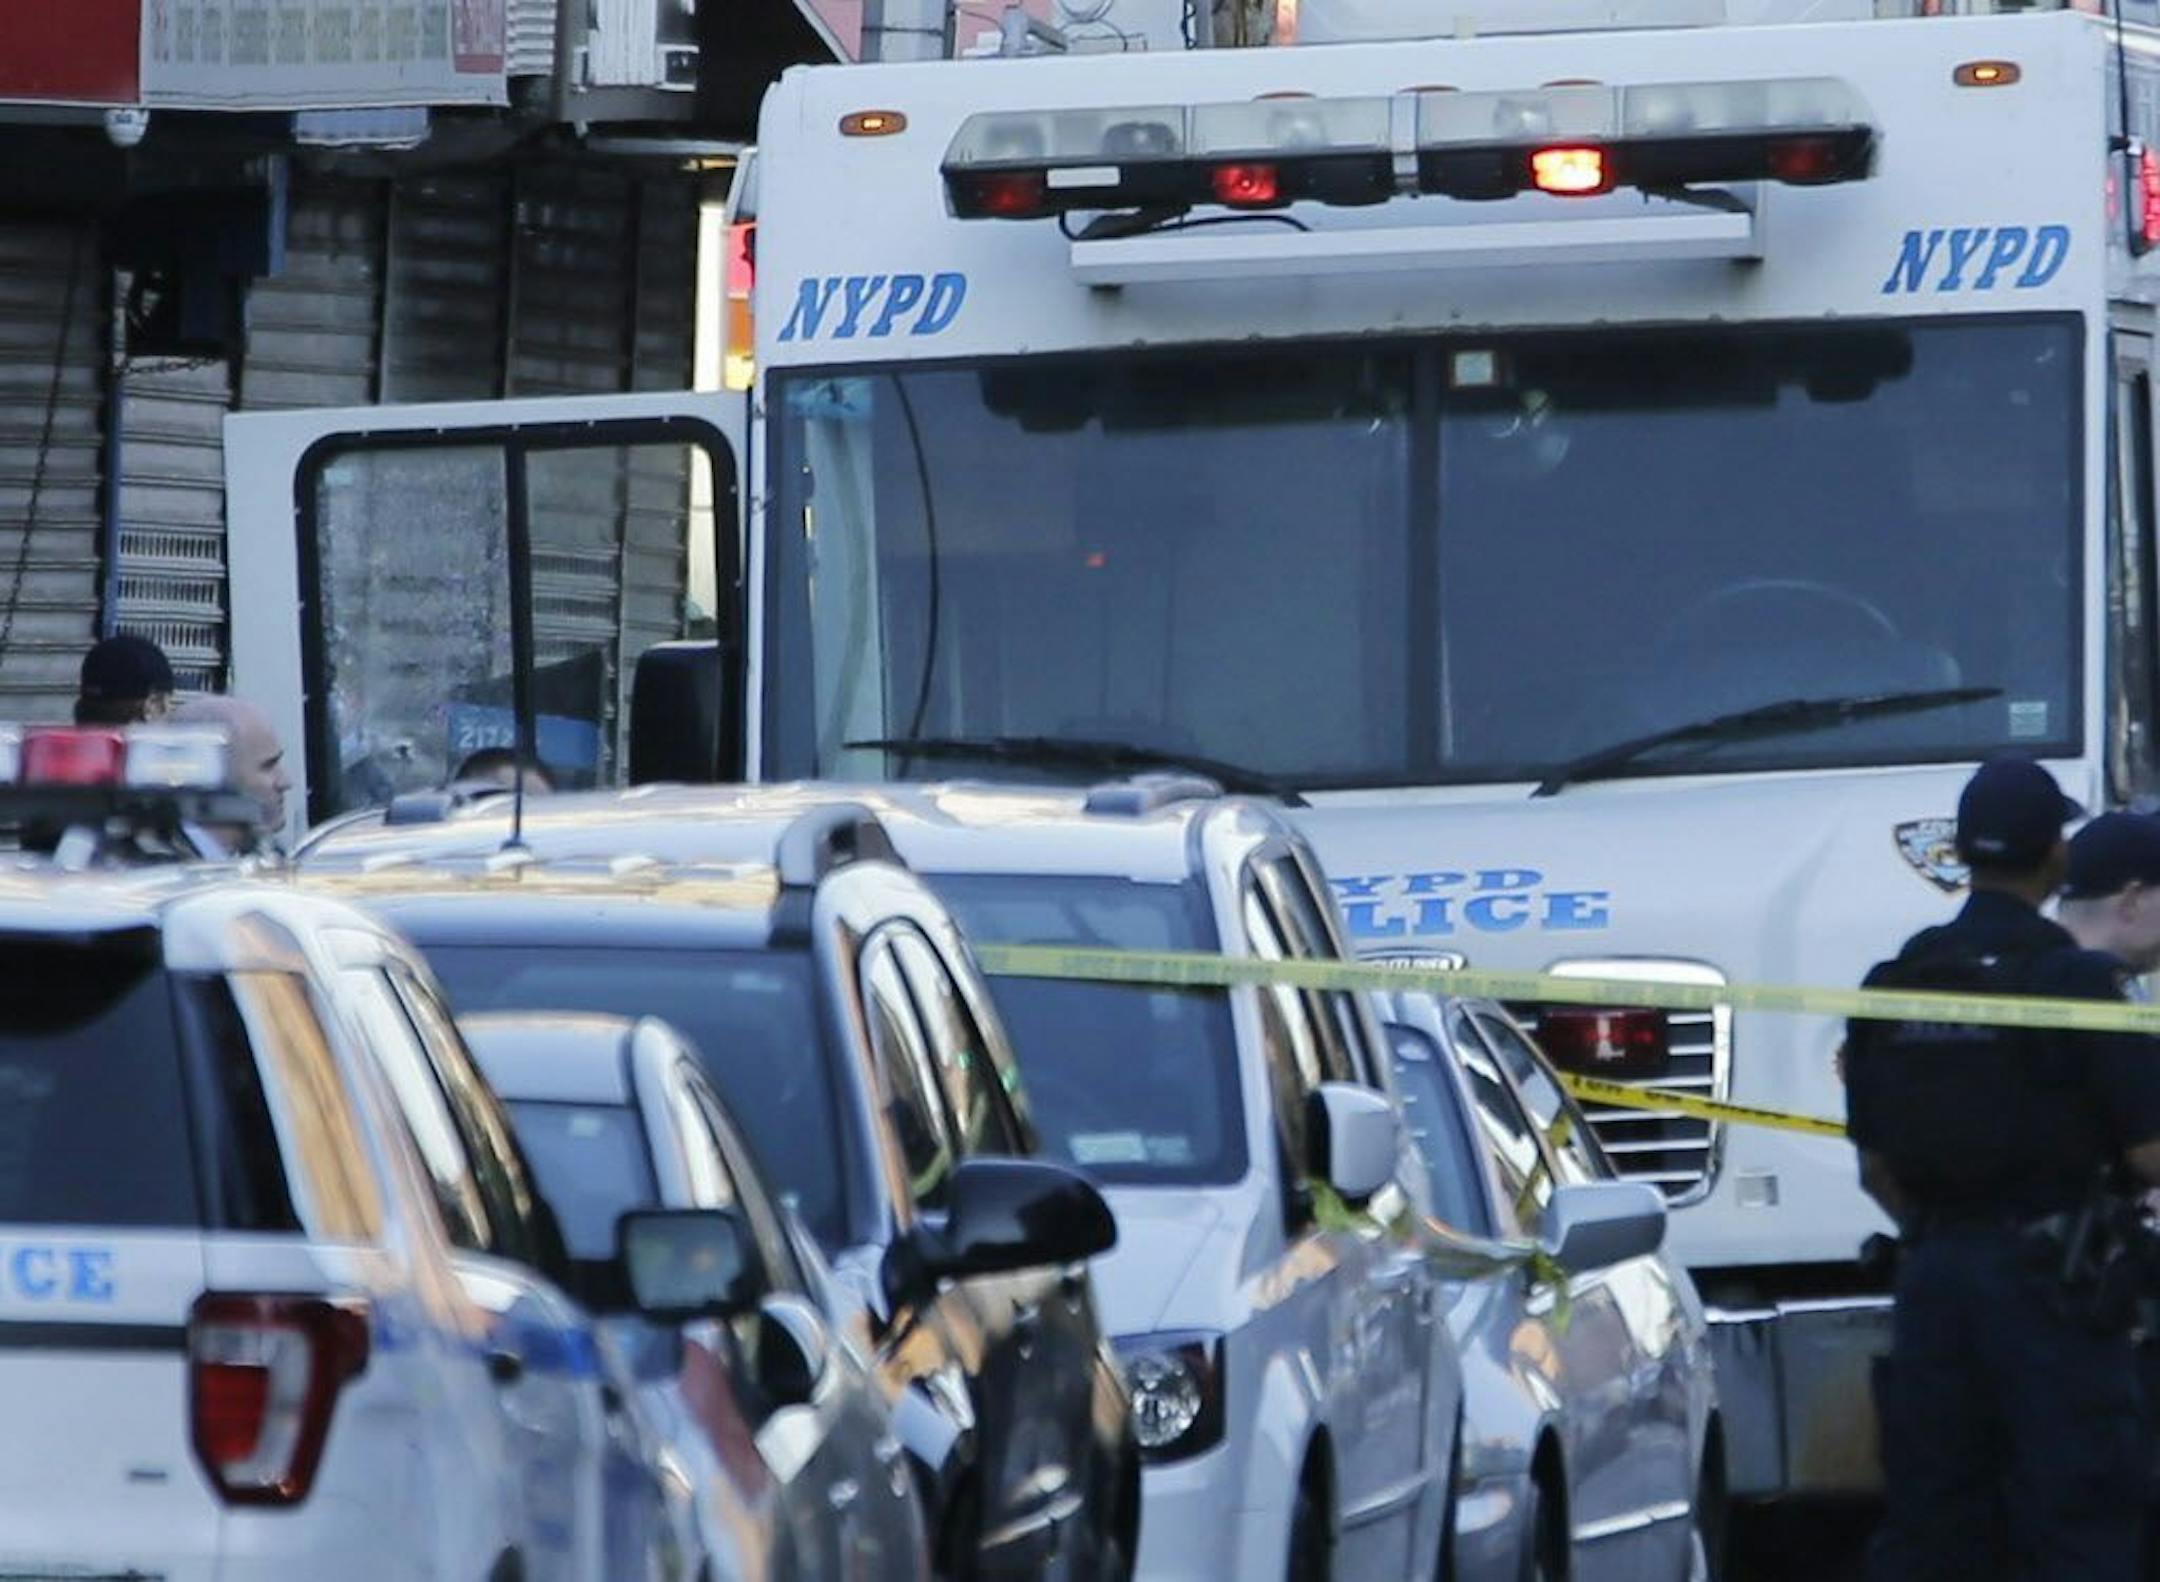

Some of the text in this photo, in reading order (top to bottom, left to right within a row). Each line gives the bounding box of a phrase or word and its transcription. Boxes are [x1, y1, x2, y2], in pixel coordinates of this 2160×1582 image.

[1880, 224, 2071, 294] NYPD
[777, 272, 968, 342] NYPD
[1327, 868, 1544, 898] YPD
[1341, 891, 1611, 937] LICE
[8, 1246, 115, 1303] CE
